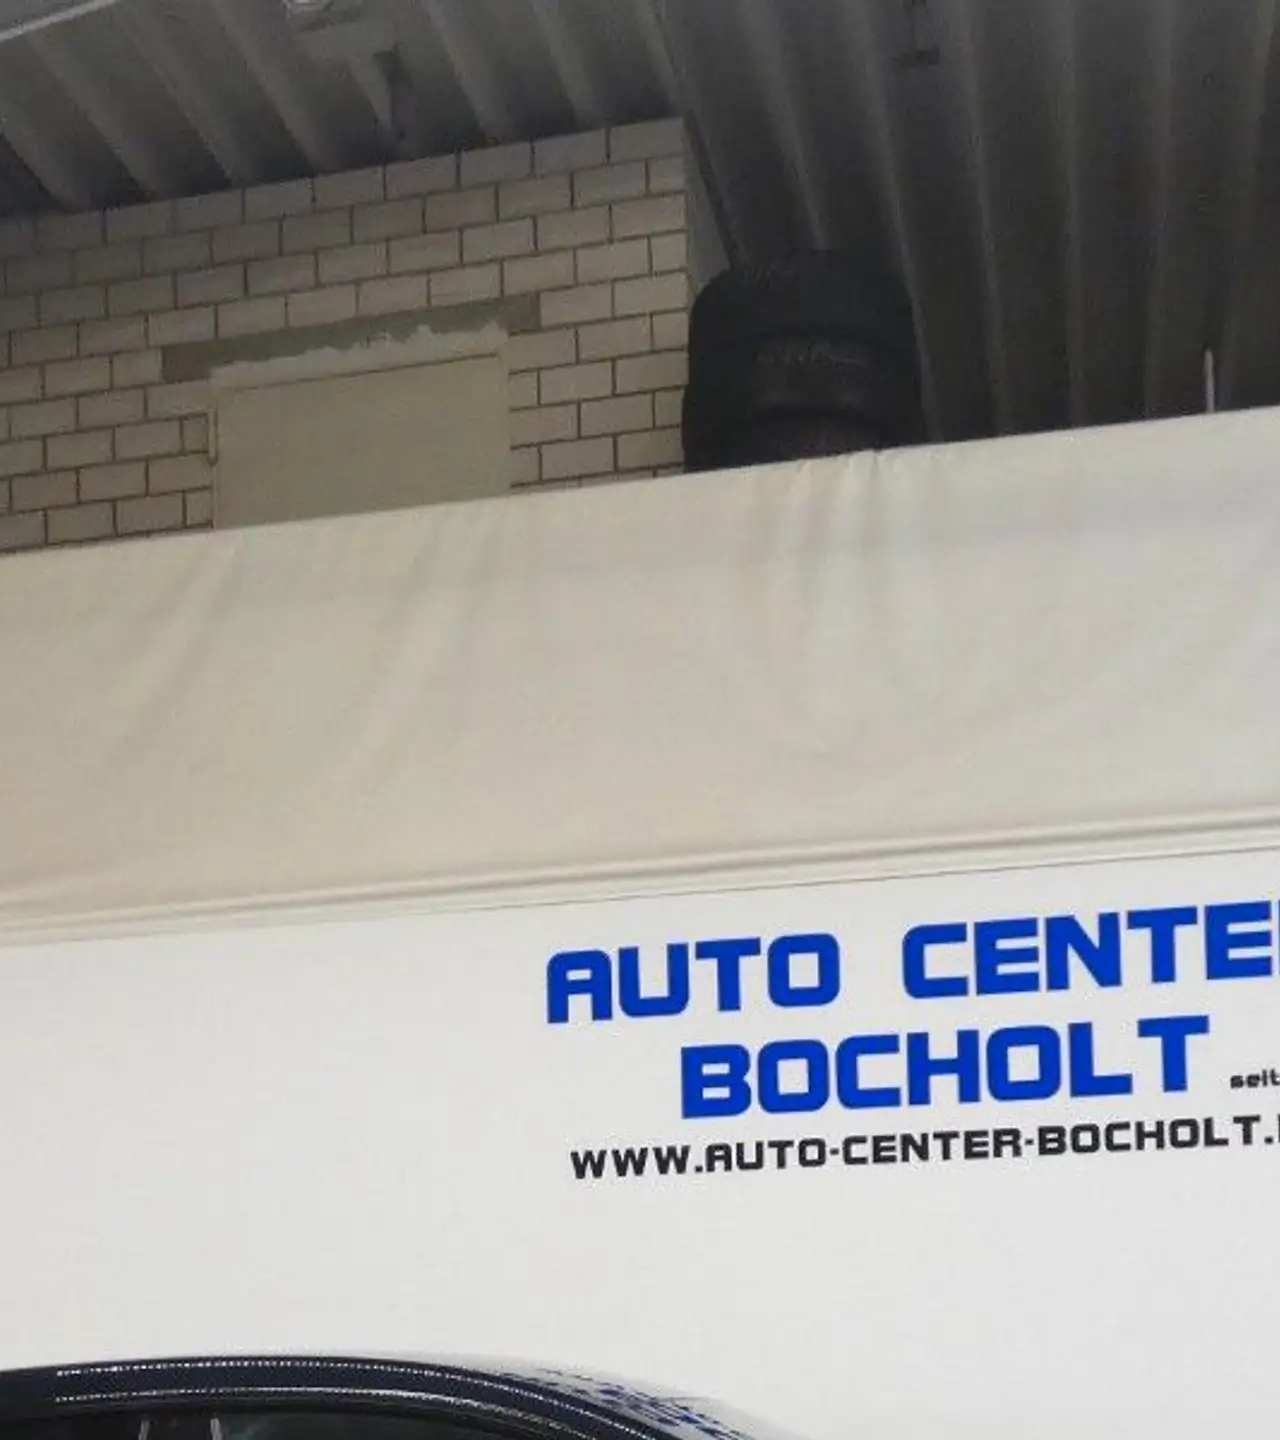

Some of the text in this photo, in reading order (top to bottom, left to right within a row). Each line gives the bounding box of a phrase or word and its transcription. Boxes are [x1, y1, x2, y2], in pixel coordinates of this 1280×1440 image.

[547, 932, 842, 1025] AUTO
[681, 1013, 1211, 1120] BOCHOLT
[1229, 1068, 1280, 1089] seit
